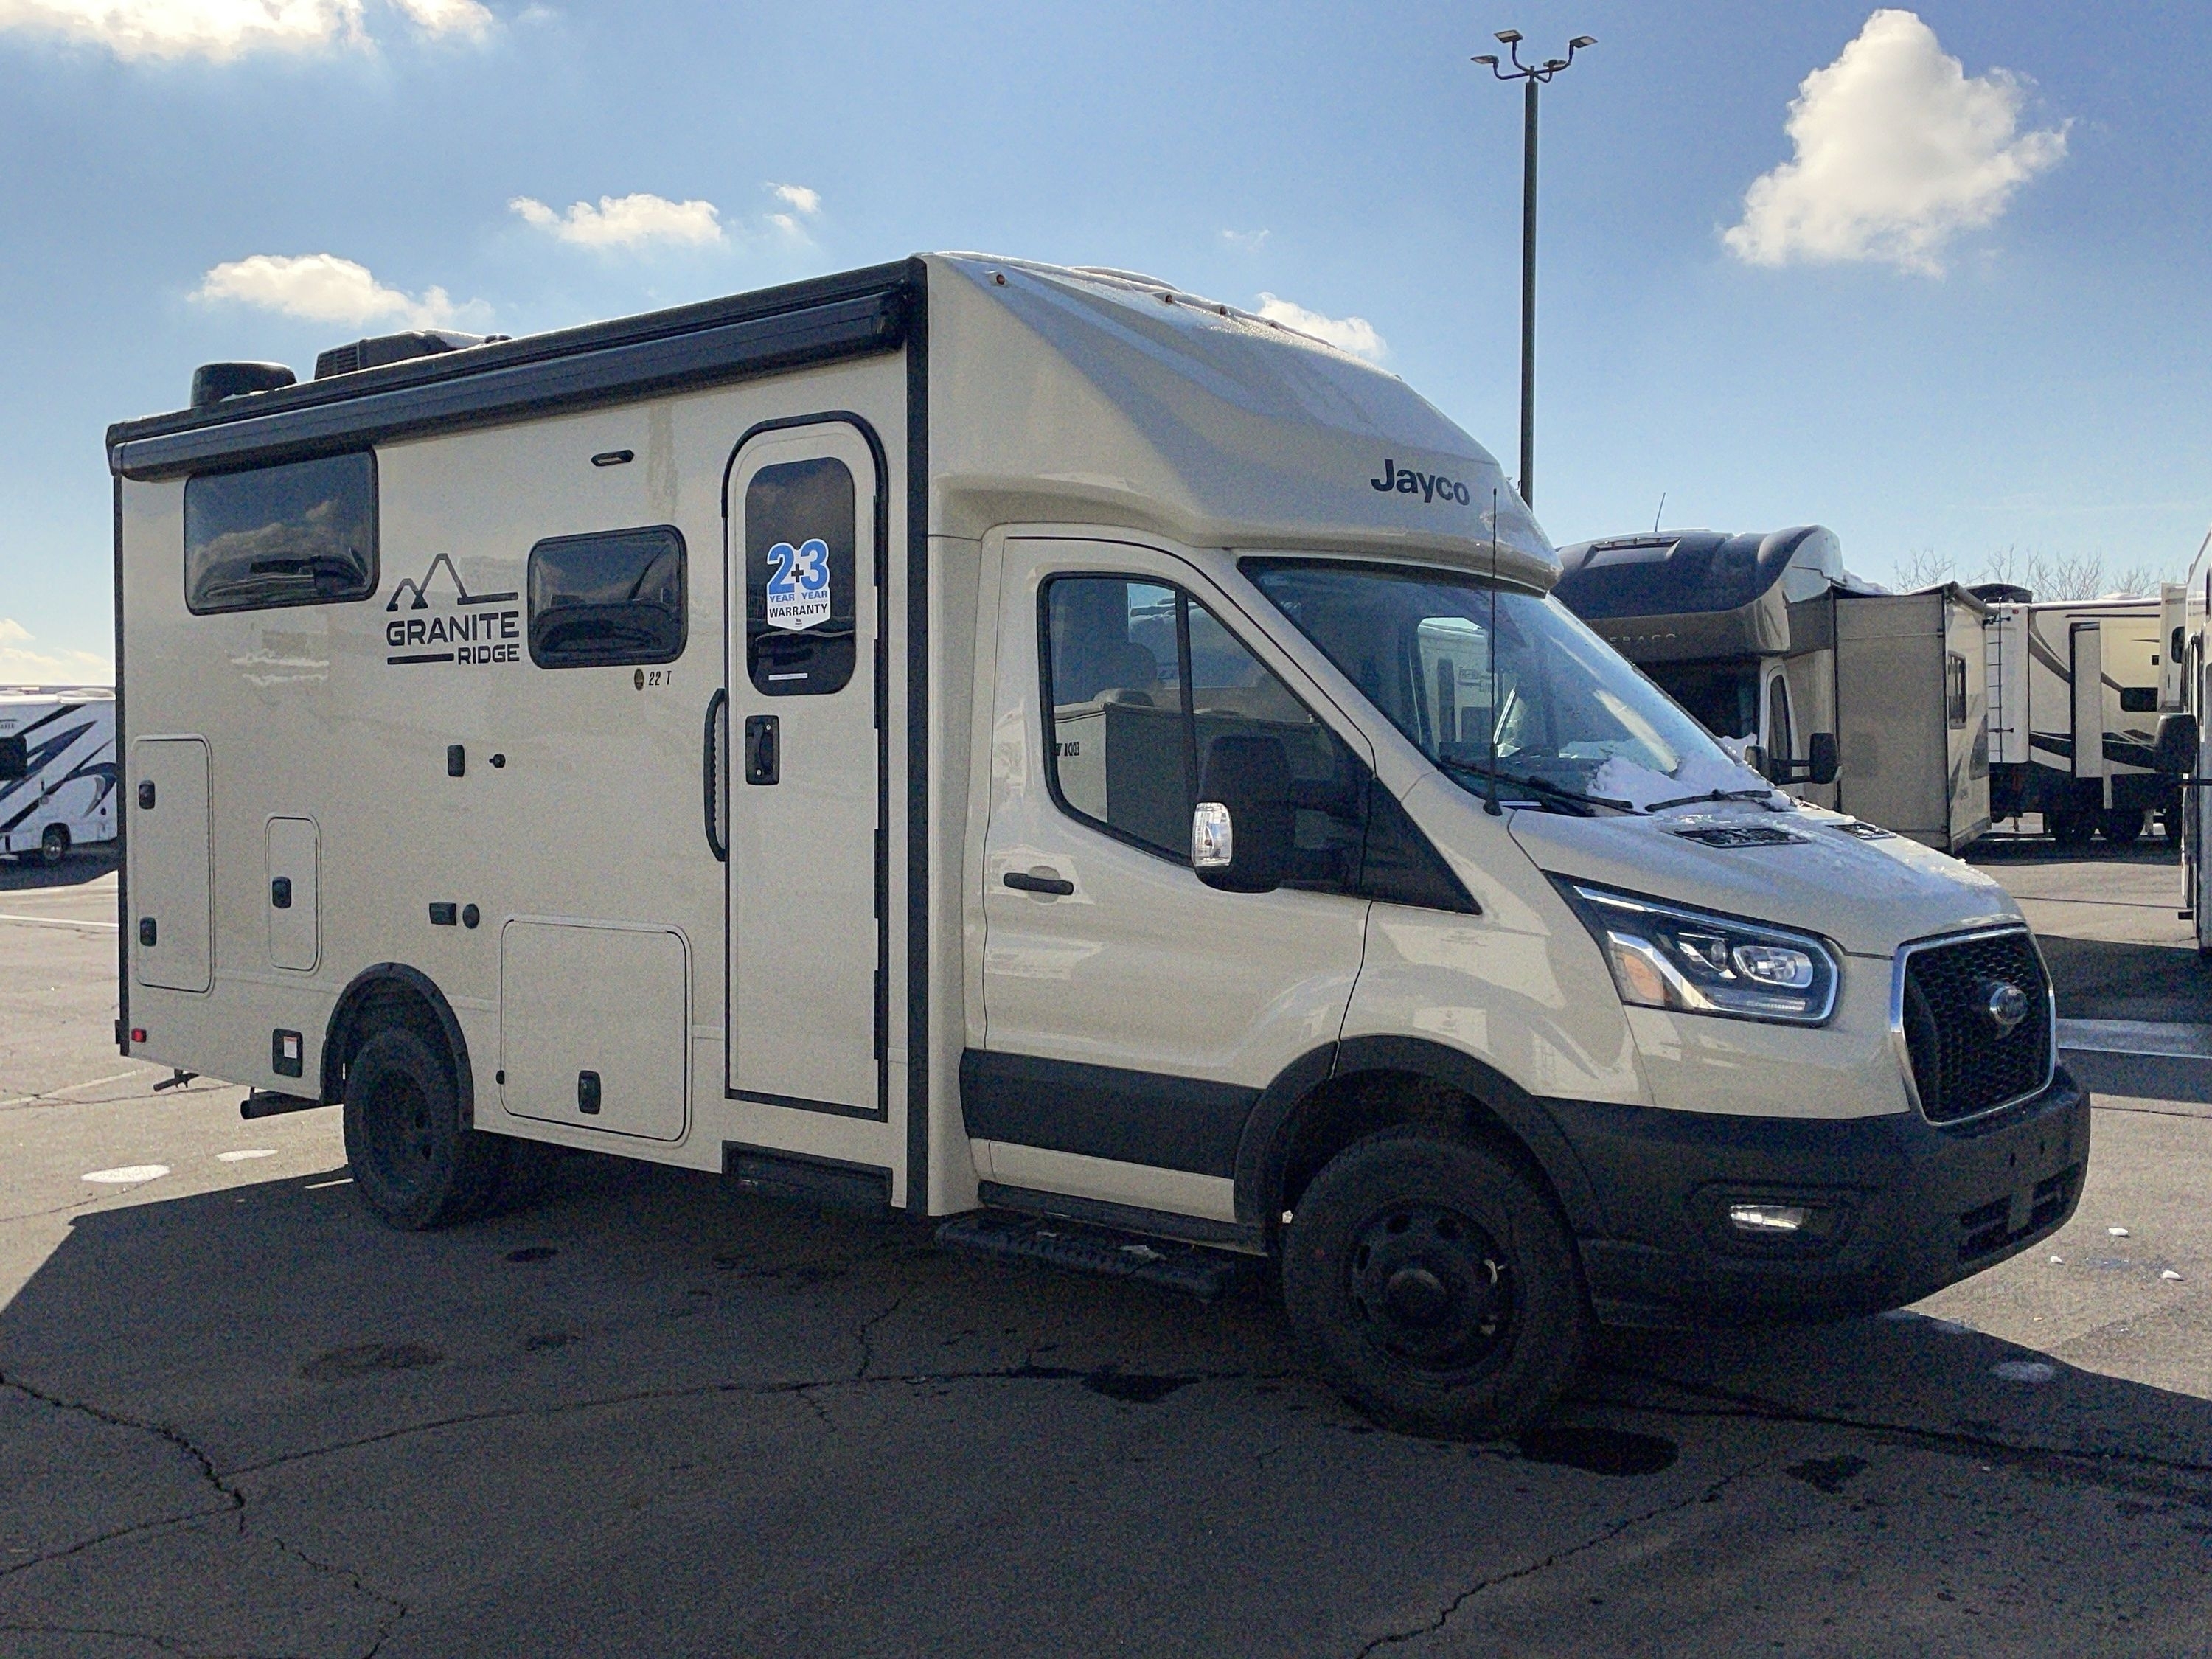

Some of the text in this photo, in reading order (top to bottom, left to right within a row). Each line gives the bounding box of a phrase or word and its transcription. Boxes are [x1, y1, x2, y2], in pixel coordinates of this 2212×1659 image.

[1370, 458, 1470, 507] Jayco
[769, 590, 828, 603] YEAR YEAR
[769, 602, 828, 619] WARRANTY
[386, 611, 520, 647] GRANITE
[457, 643, 520, 665] RIDGE
[648, 670, 672, 686] 22 T
